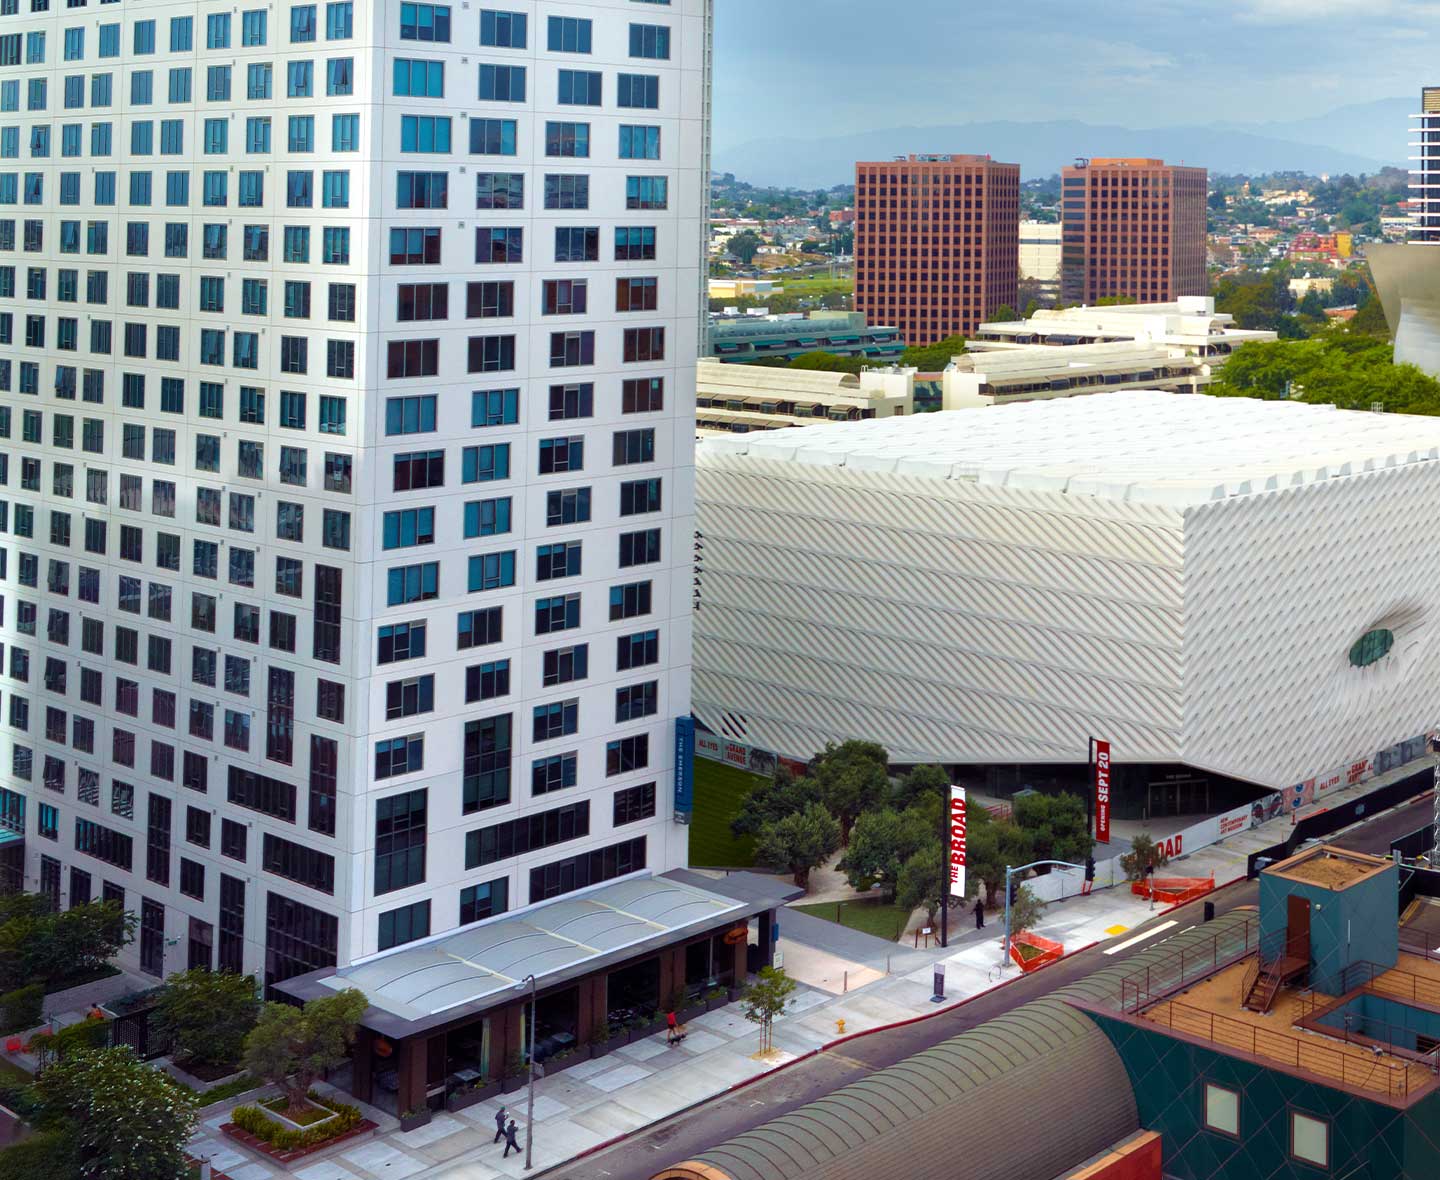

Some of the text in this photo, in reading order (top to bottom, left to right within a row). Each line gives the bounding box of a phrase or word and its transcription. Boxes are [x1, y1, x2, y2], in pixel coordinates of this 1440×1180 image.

[729, 743, 747, 756] GRAND
[727, 752, 747, 765] AVENUE
[1098, 752, 1109, 769] 20
[1098, 770, 1109, 803] SEPT
[1320, 776, 1340, 790] ALL EYES
[950, 797, 967, 884] THE BROAD
